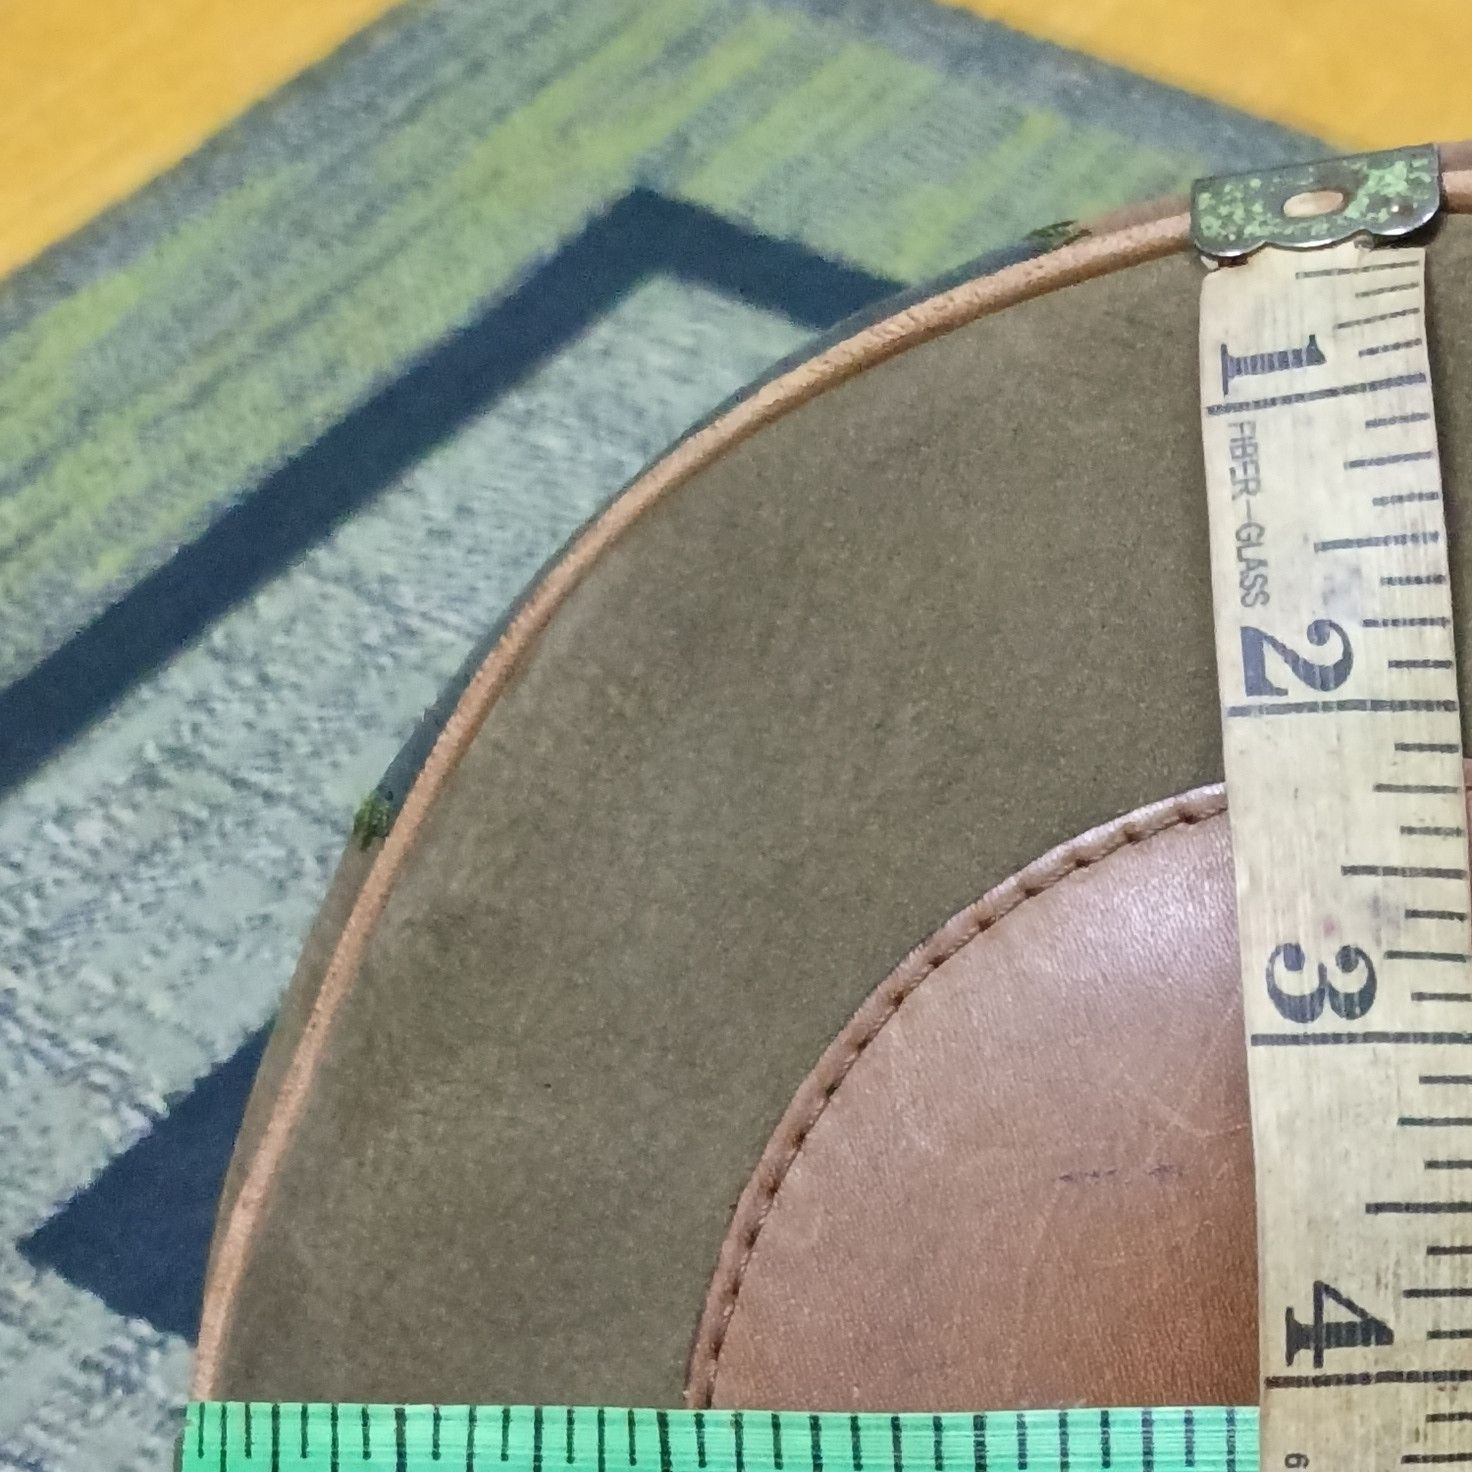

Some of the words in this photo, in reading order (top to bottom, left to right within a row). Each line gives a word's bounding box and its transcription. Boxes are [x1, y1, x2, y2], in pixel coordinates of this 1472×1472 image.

[1220, 334, 1326, 396] 1
[1240, 619, 1354, 698] 2
[1266, 943, 1377, 1023] 3
[1285, 1281, 1394, 1368] 4
